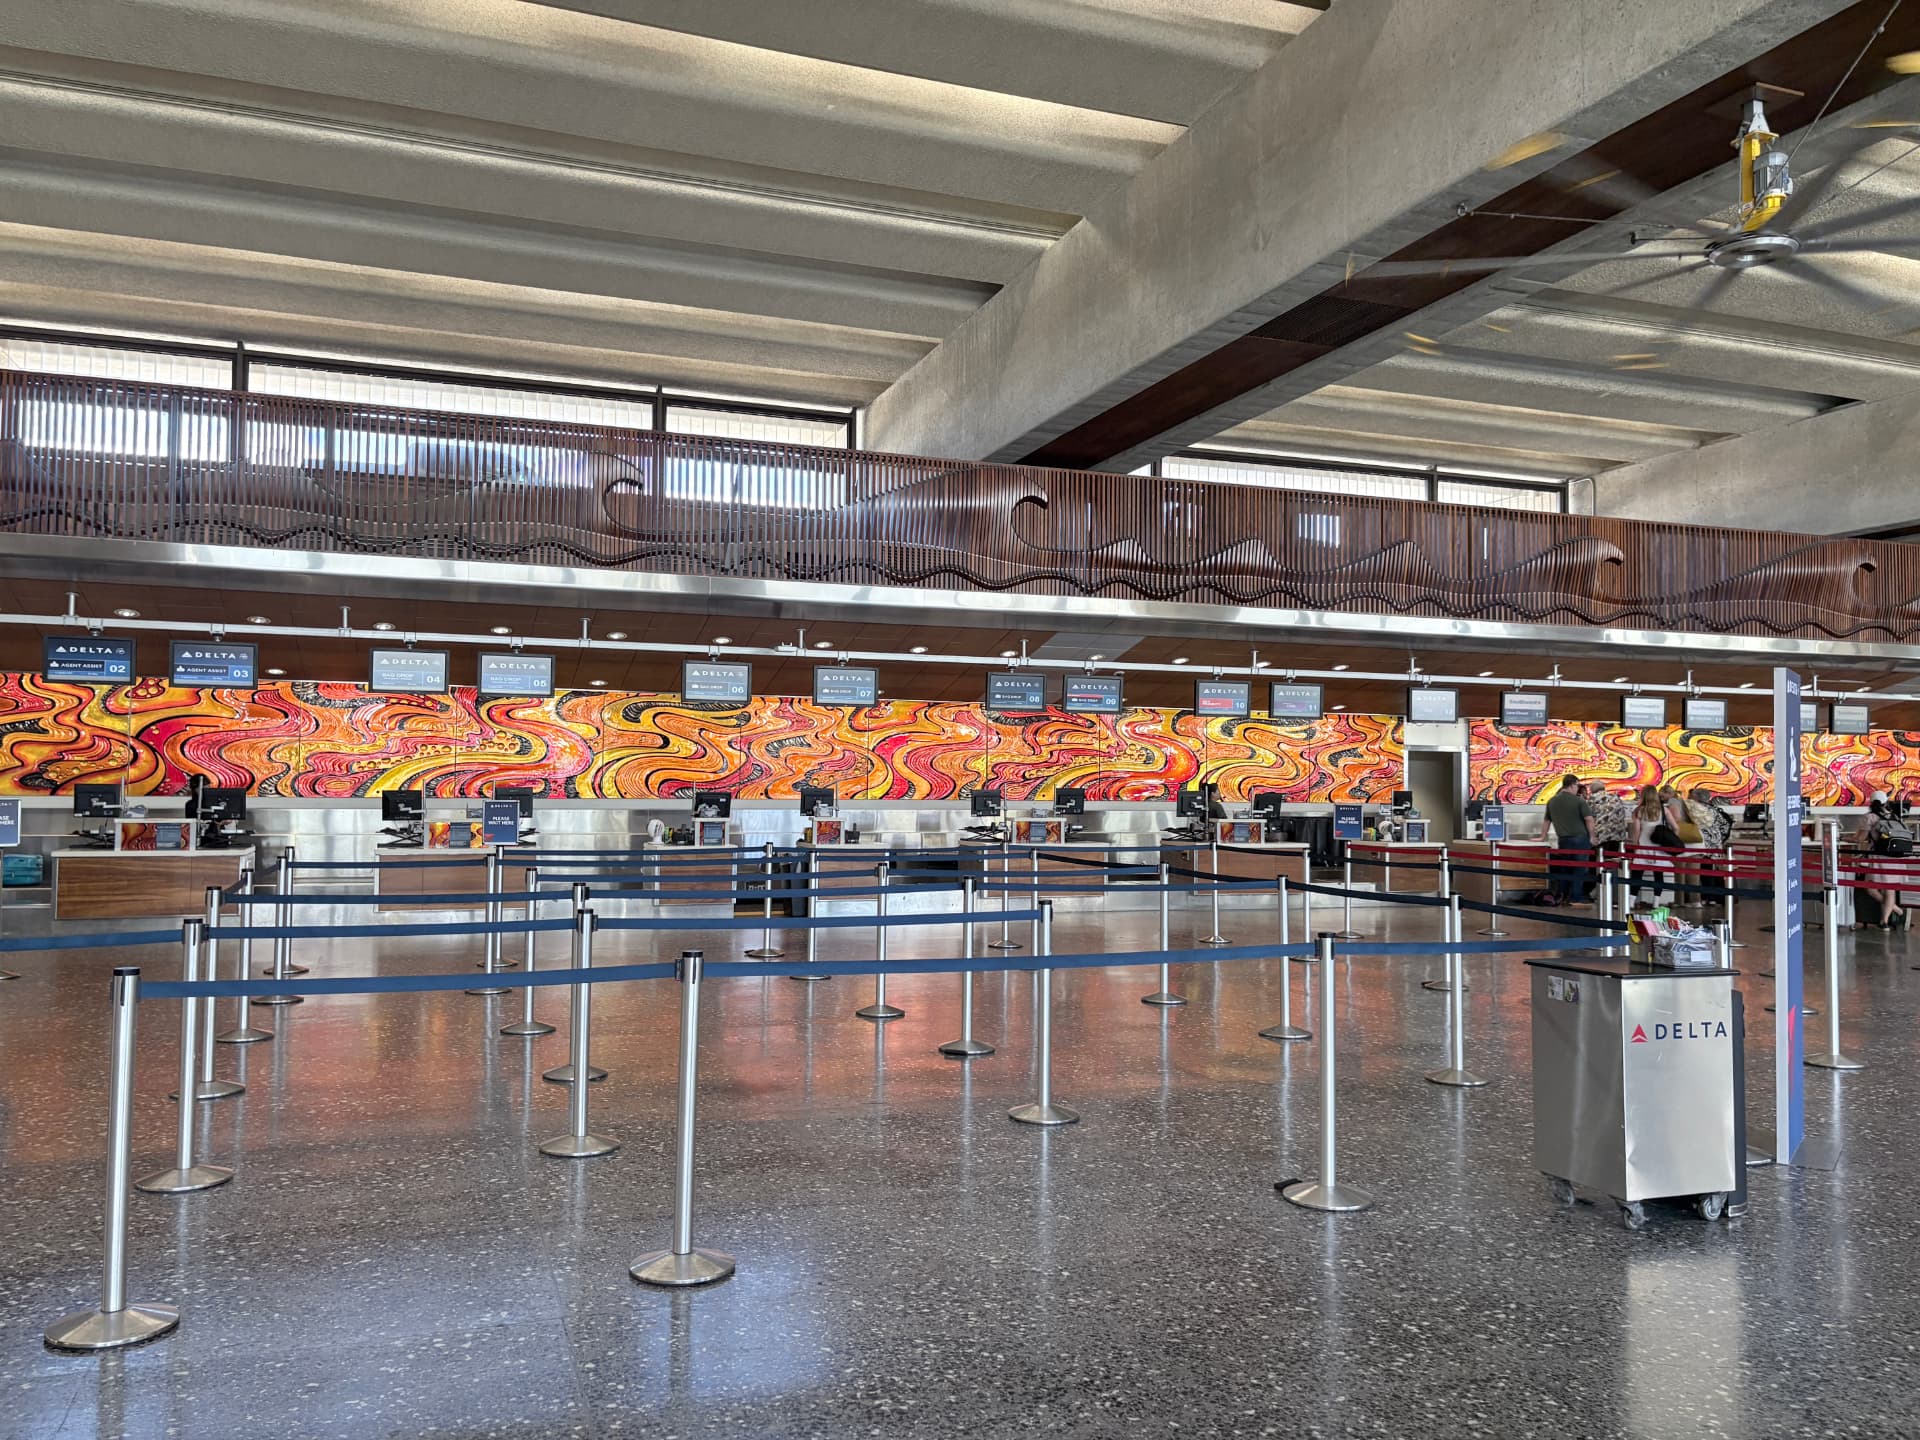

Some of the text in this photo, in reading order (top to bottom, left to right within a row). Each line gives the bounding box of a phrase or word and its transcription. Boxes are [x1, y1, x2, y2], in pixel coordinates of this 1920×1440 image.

[69, 646, 112, 654] DELTA
[195, 651, 236, 659] DELTA
[392, 658, 430, 666] DELTA
[109, 665, 126, 673] 02
[233, 670, 249, 678] 03
[426, 675, 440, 683] 04
[731, 686, 745, 694] 06
[1655, 1021, 1727, 1040] DELTA
